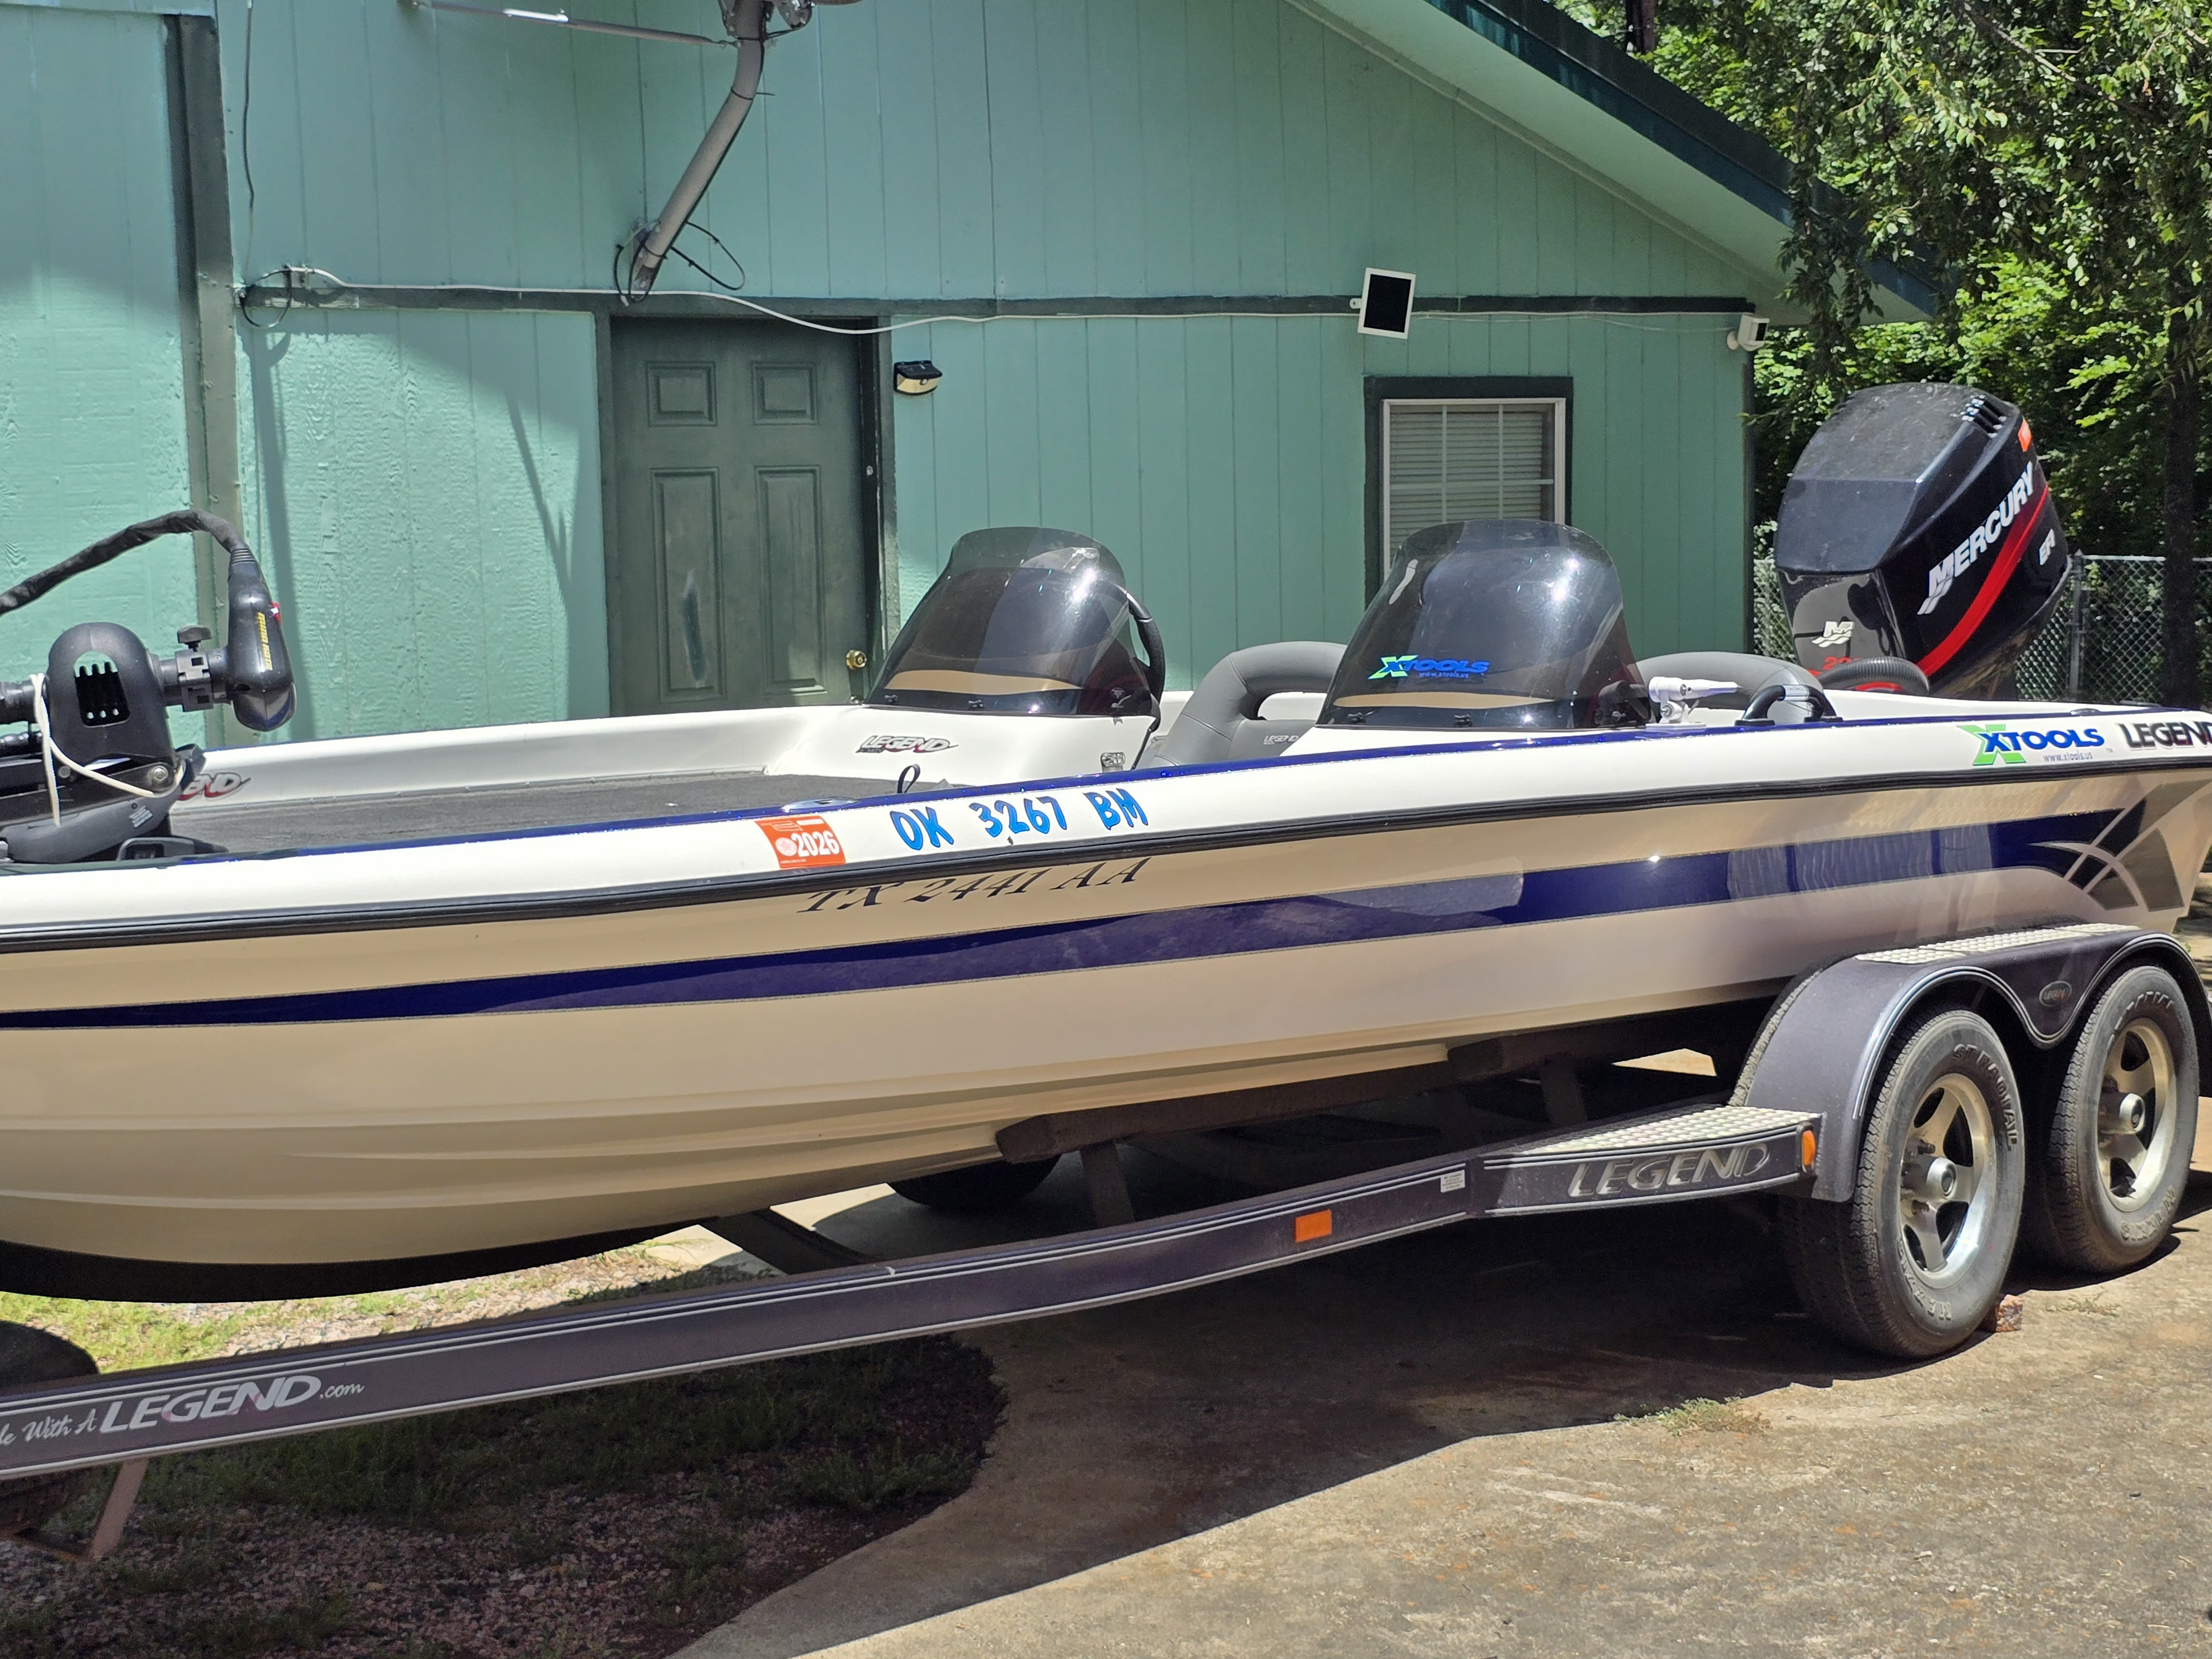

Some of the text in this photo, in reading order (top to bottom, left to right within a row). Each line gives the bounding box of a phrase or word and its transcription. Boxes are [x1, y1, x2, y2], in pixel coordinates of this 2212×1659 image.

[1917, 461, 2033, 614] MERCURY
[1368, 655, 1490, 680] XTOOLS
[860, 735, 951, 753] LEGEND
[1957, 724, 2105, 766] XTOOLS
[889, 788, 1149, 851] OK 3267 BM
[791, 831, 839, 857] 2026
[796, 857, 1152, 913] TX 2441 AA
[1568, 1143, 1770, 1197] LEGEND
[21, 1415, 73, 1442] With
[74, 1408, 98, 1435] A
